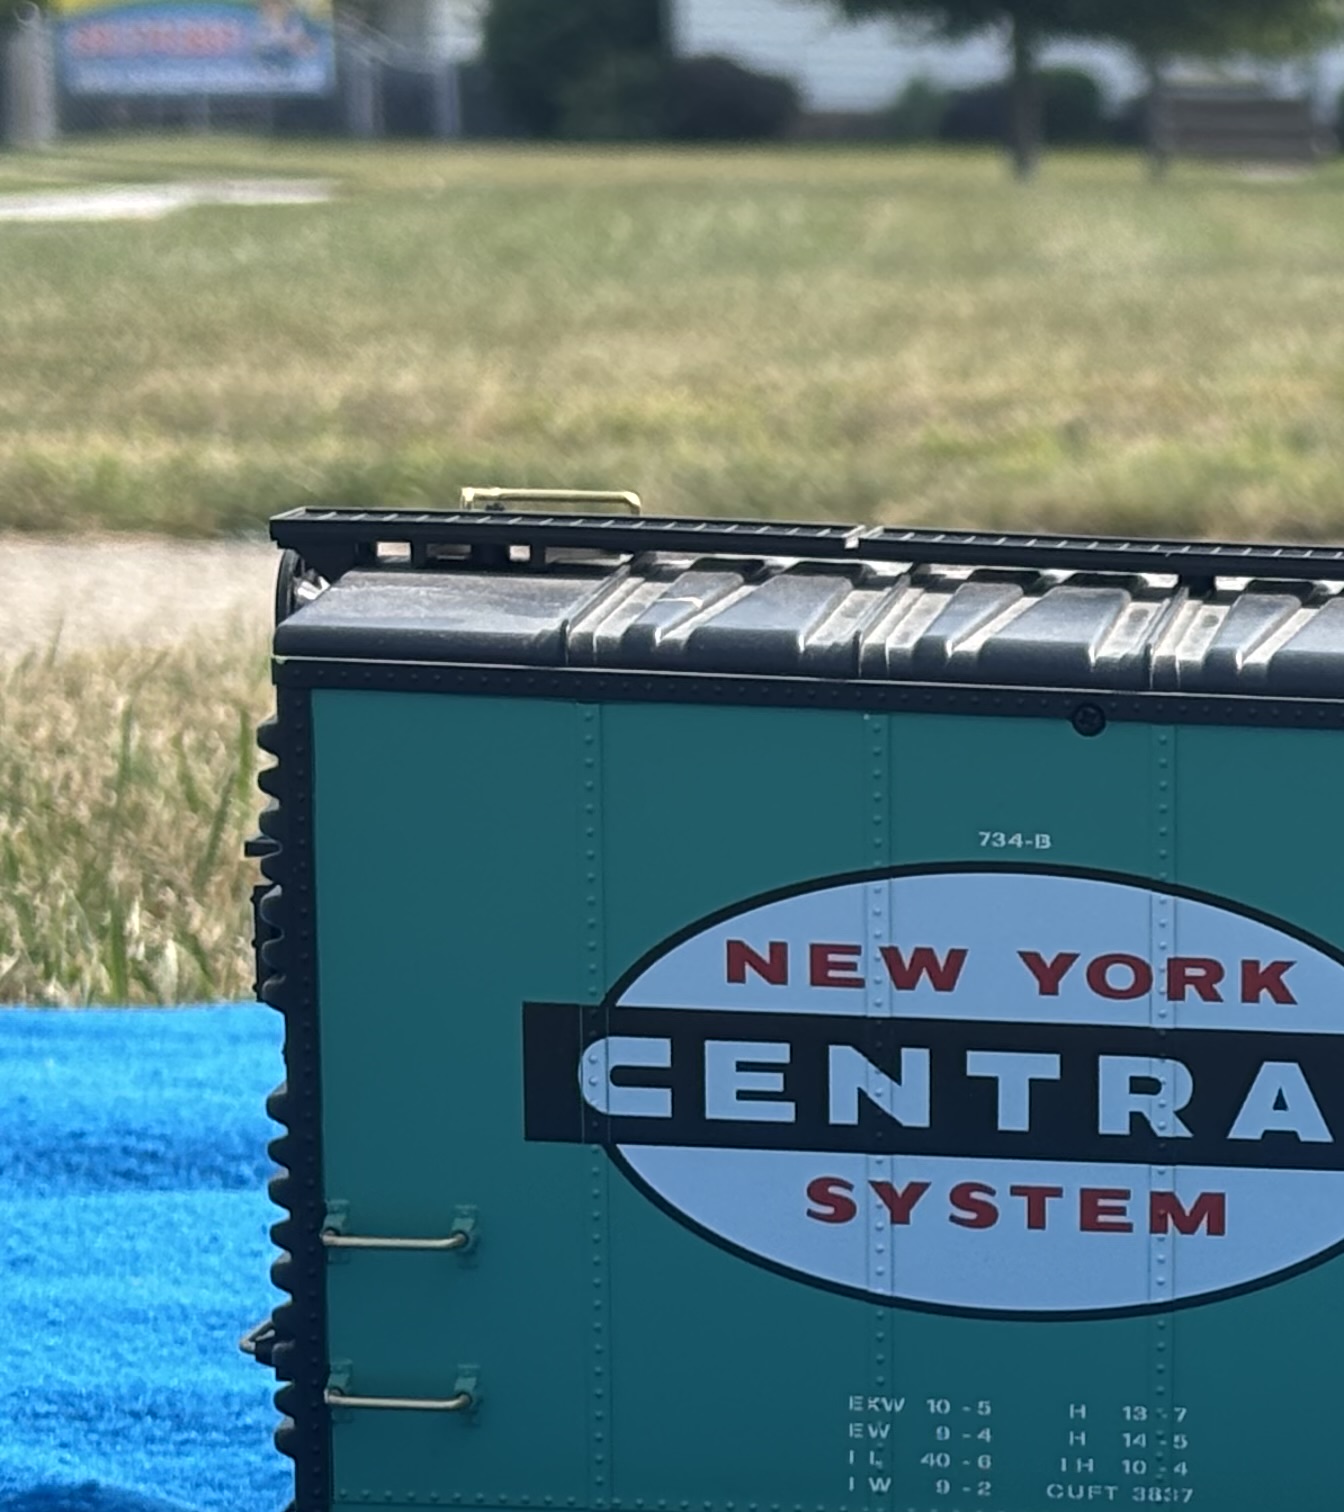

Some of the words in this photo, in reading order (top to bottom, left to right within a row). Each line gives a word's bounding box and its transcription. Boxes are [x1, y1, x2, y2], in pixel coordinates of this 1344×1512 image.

[978, 831, 1052, 850] 734-B
[725, 940, 967, 992] NEW
[1018, 951, 1298, 1004] YORK
[806, 1176, 1226, 1236] SYSTEM
